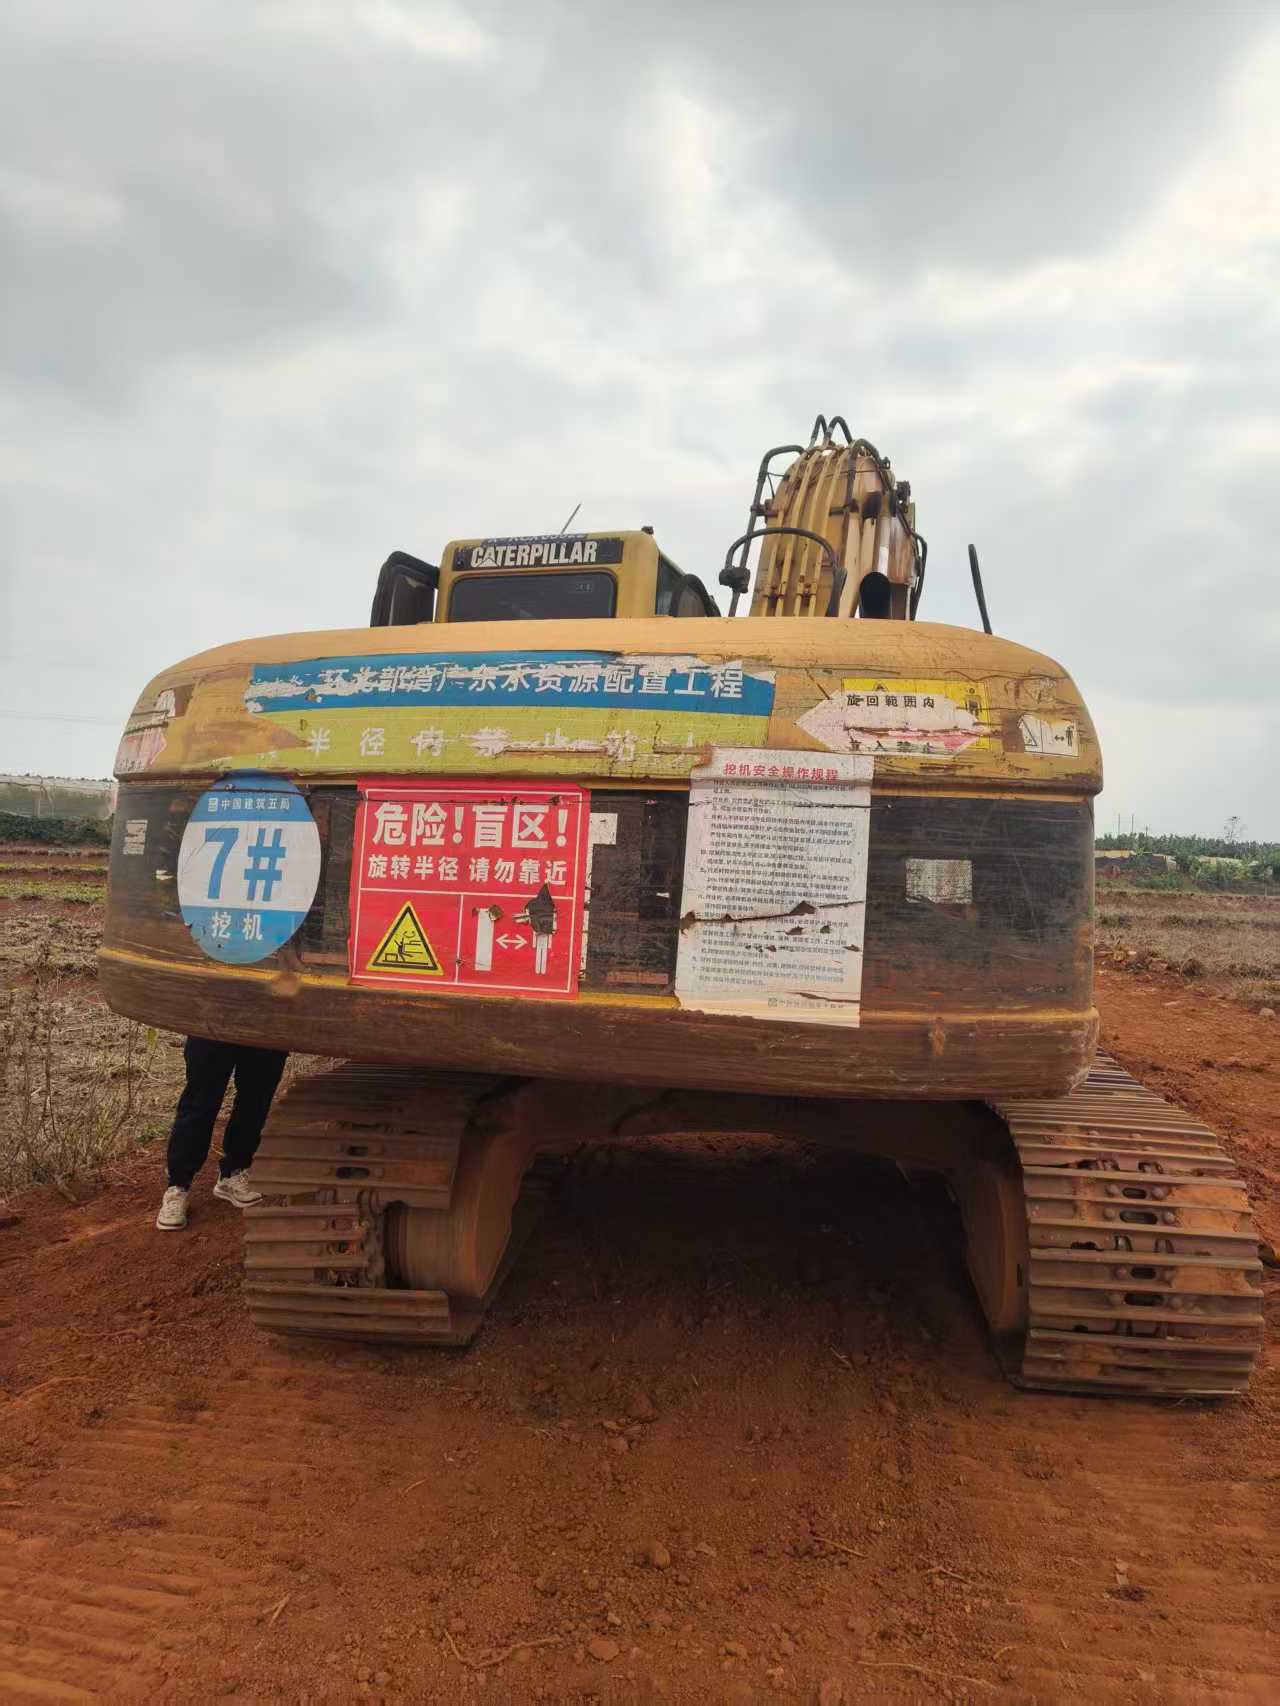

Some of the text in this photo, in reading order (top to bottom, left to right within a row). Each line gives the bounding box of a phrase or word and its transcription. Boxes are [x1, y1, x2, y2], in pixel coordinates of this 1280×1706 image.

[470, 541, 598, 568] CATERPILLAR
[722, 761, 840, 784] 挖机安全操作规程
[219, 798, 291, 812] 中国建筑五局
[372, 802, 569, 849] 危险!盲区!
[203, 827, 287, 902] 7#
[367, 853, 568, 886] 旋转半径 请勿靠近
[210, 911, 264, 941] 挖机
